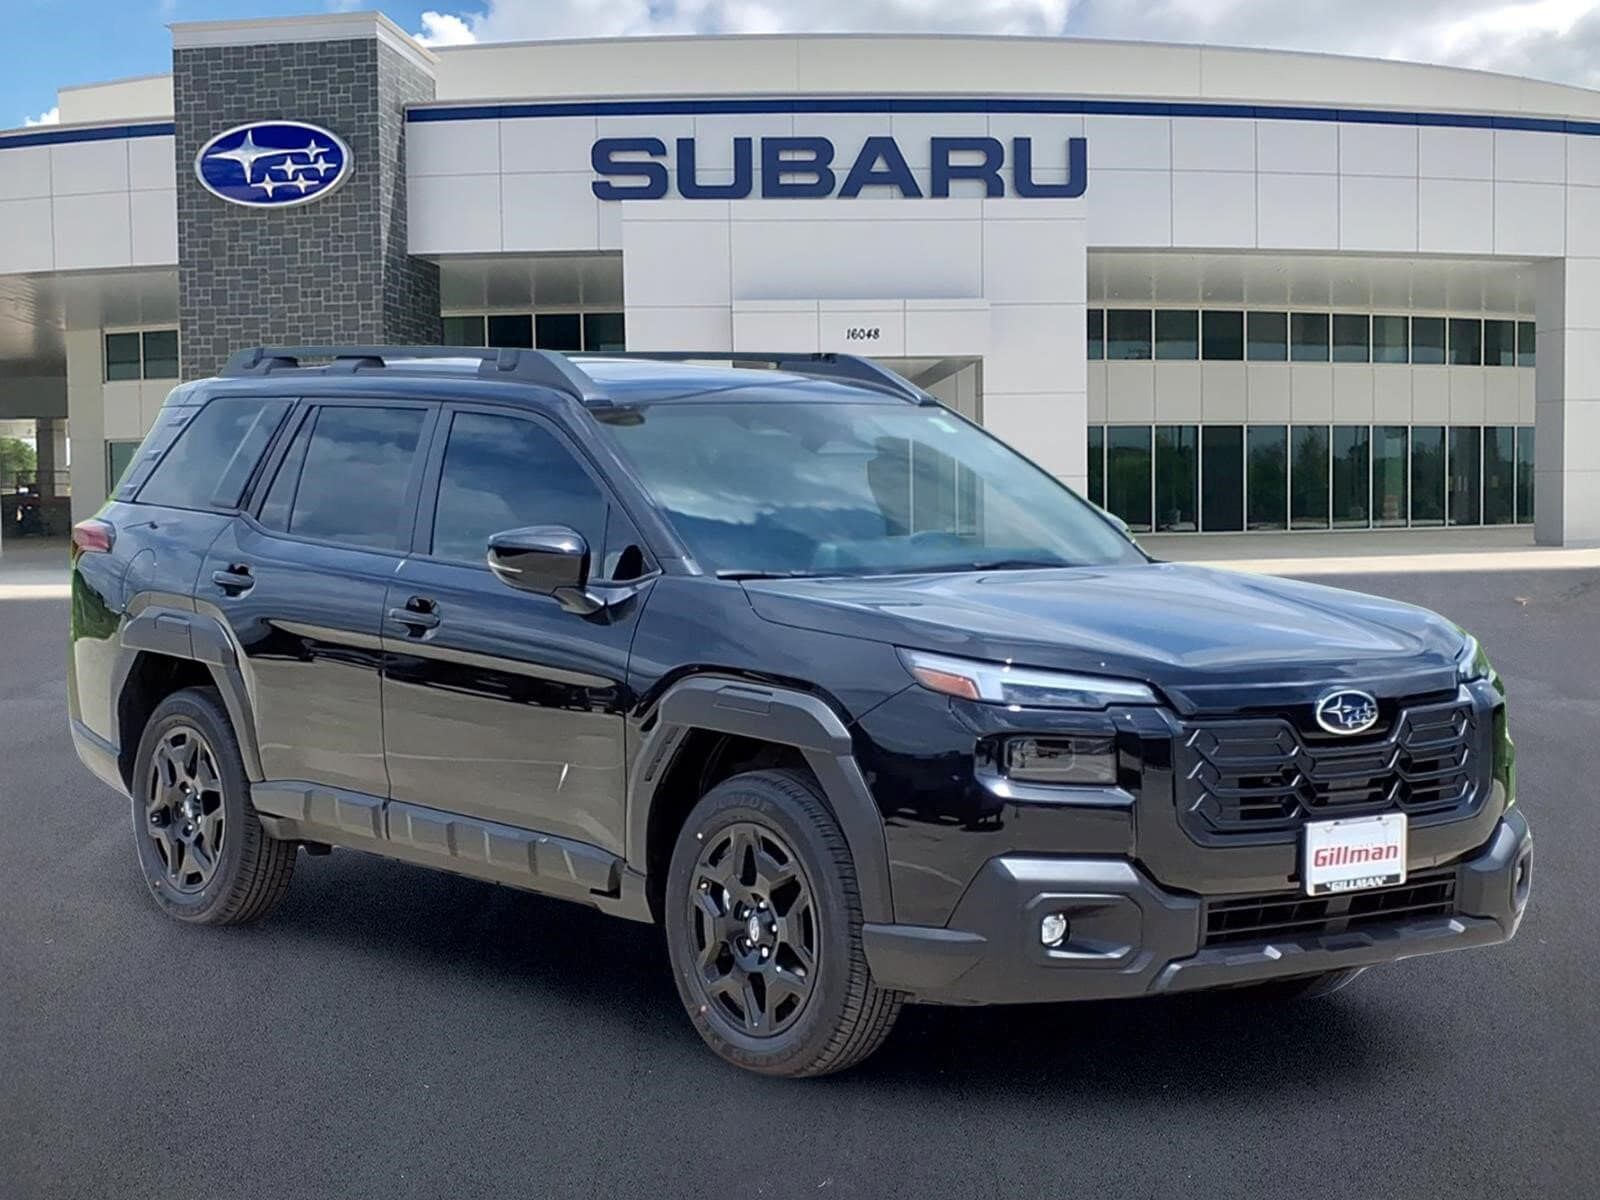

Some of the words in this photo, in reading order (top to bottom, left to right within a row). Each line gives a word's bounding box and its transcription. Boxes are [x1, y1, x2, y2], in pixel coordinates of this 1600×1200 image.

[591, 136, 1087, 199] SUBARU
[846, 328, 880, 340] 16048
[1314, 845, 1398, 867] Gillman
